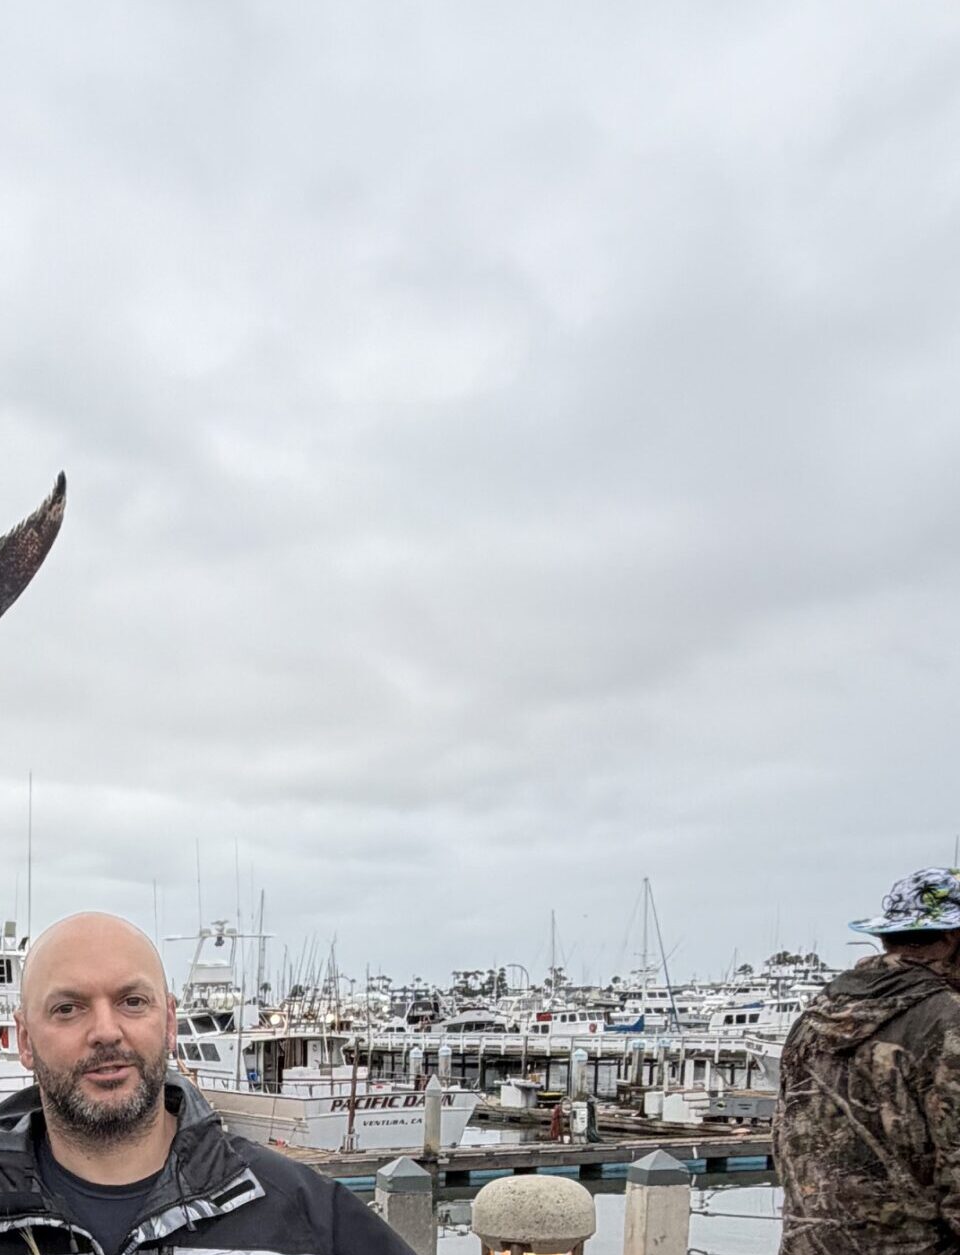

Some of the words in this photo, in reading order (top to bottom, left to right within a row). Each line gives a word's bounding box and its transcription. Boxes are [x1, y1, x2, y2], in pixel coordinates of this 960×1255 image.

[330, 1096, 401, 1112] PACIFIC
[402, 1095, 456, 1109] DAN
[410, 1117, 423, 1125] CA
